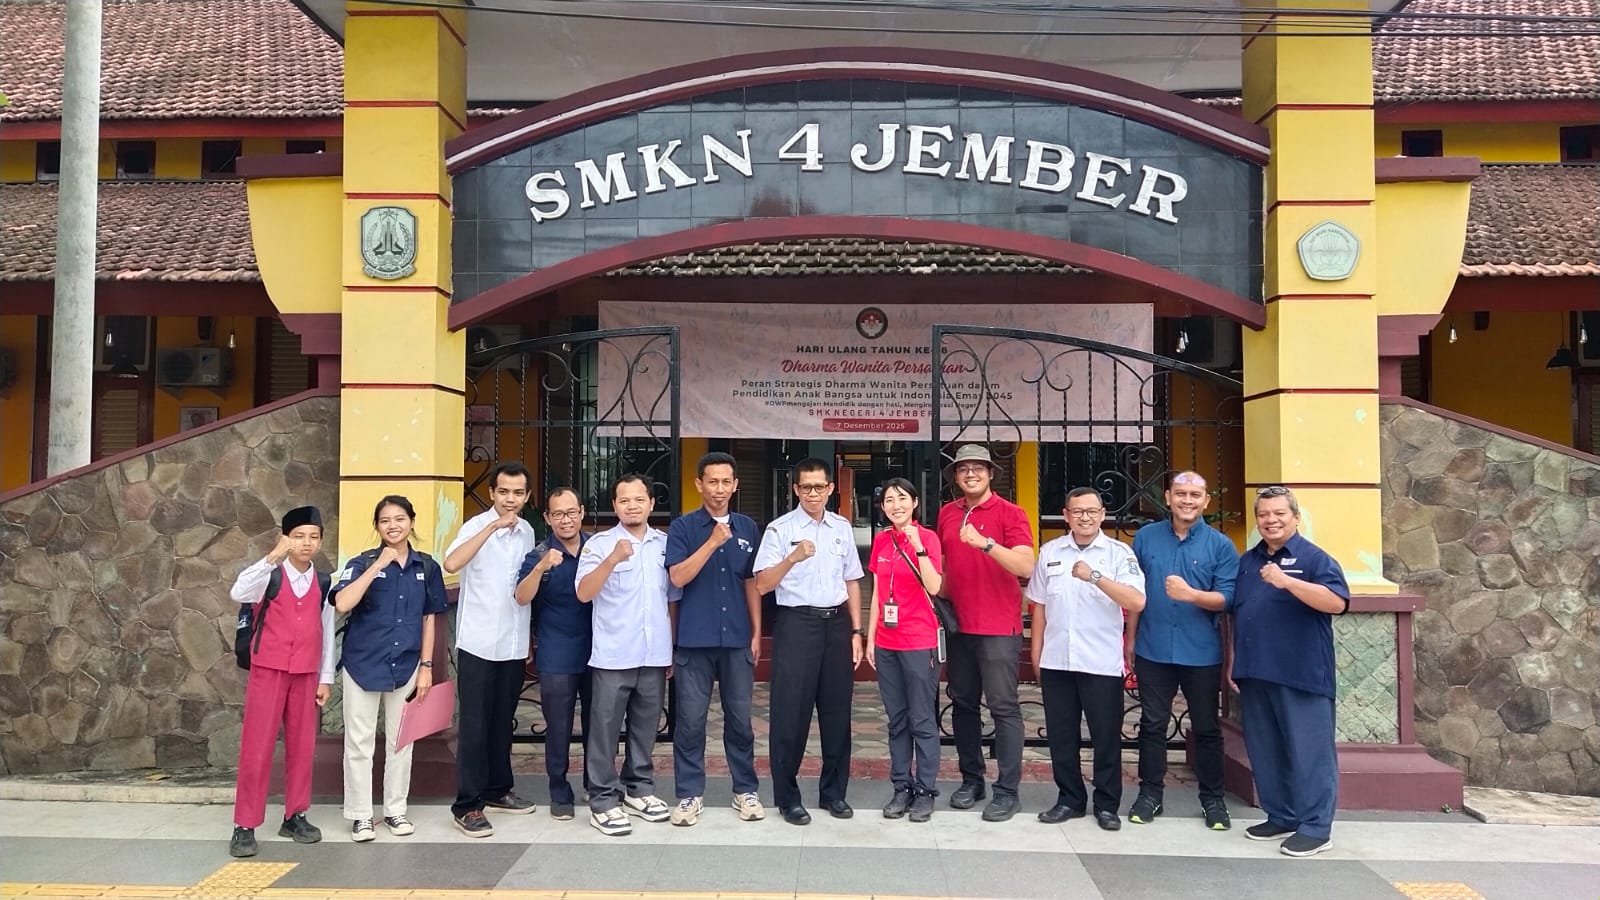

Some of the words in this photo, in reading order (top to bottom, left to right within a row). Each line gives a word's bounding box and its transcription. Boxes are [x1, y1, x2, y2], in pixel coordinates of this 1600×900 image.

[525, 129, 753, 223] SMKN
[778, 123, 823, 171] 4
[850, 122, 1188, 224] JEMBER
[796, 345, 824, 354] HARI
[828, 345, 867, 354] ULANG
[871, 346, 911, 354] TAHUN
[781, 359, 839, 373] Dharma
[840, 360, 891, 374] Wanita
[741, 380, 771, 388] Peran
[774, 380, 822, 390] Strategis
[825, 380, 866, 388] Dharma
[870, 381, 907, 389] Wanita
[732, 389, 791, 398] Pendidikan
[794, 390, 821, 398] Anak
[824, 391, 862, 400] Bangsa
[866, 391, 897, 399] untuk
[843, 422, 884, 430] Desember
